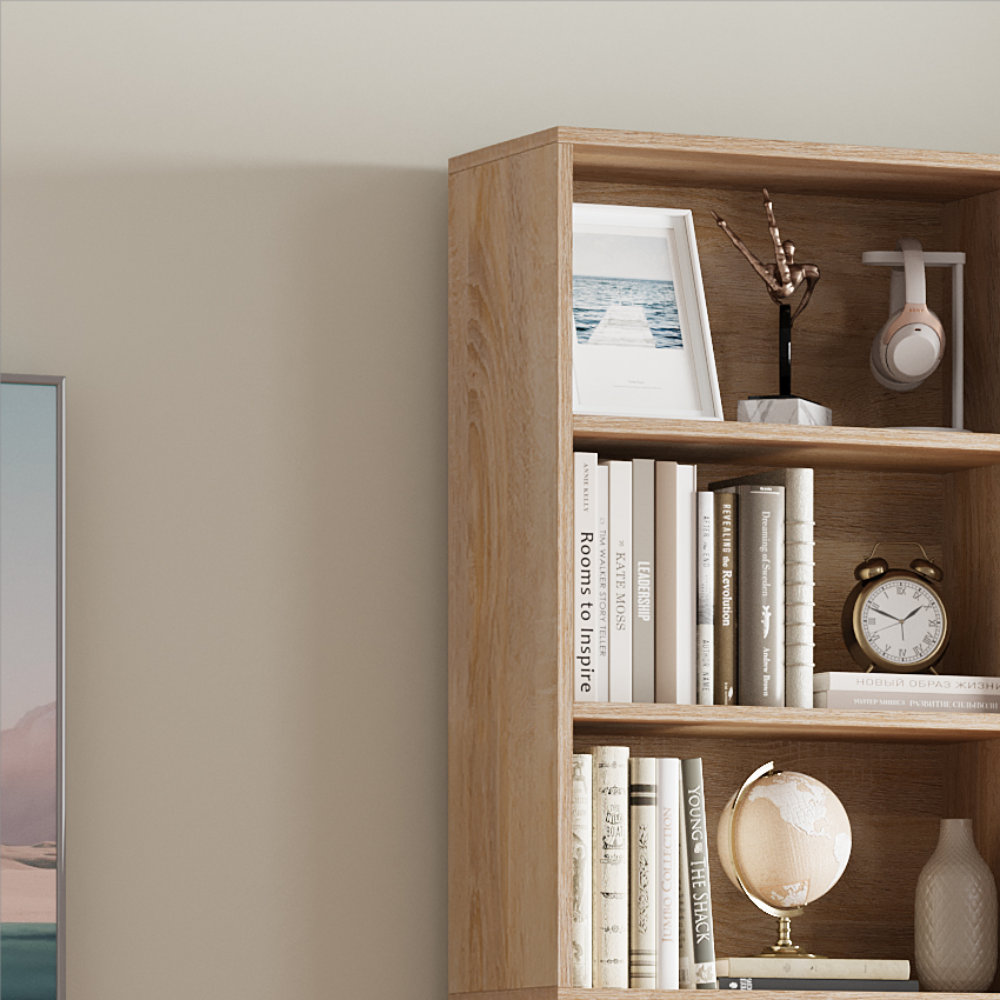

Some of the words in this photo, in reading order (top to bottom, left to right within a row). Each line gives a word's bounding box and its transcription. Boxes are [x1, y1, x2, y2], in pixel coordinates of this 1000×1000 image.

[722, 504, 732, 553] REVEALING
[760, 511, 771, 552] Dreaming
[580, 532, 594, 595] Rooms
[615, 552, 625, 588] KATE
[580, 601, 592, 621] to
[615, 593, 626, 631] MOSS
[637, 561, 650, 621] LEADERSHIP
[722, 570, 733, 626] Revolution
[576, 628, 593, 693] Inspire
[762, 647, 771, 673] Andrew
[856, 677, 905, 688] НОВЫЙ
[909, 679, 952, 689] ОБРАЗ
[687, 785, 702, 841] YOUNG
[661, 807, 673, 892] COLLECTION
[690, 855, 707, 888] THE
[661, 897, 673, 943] JUMBO
[693, 892, 711, 945] SHACK
